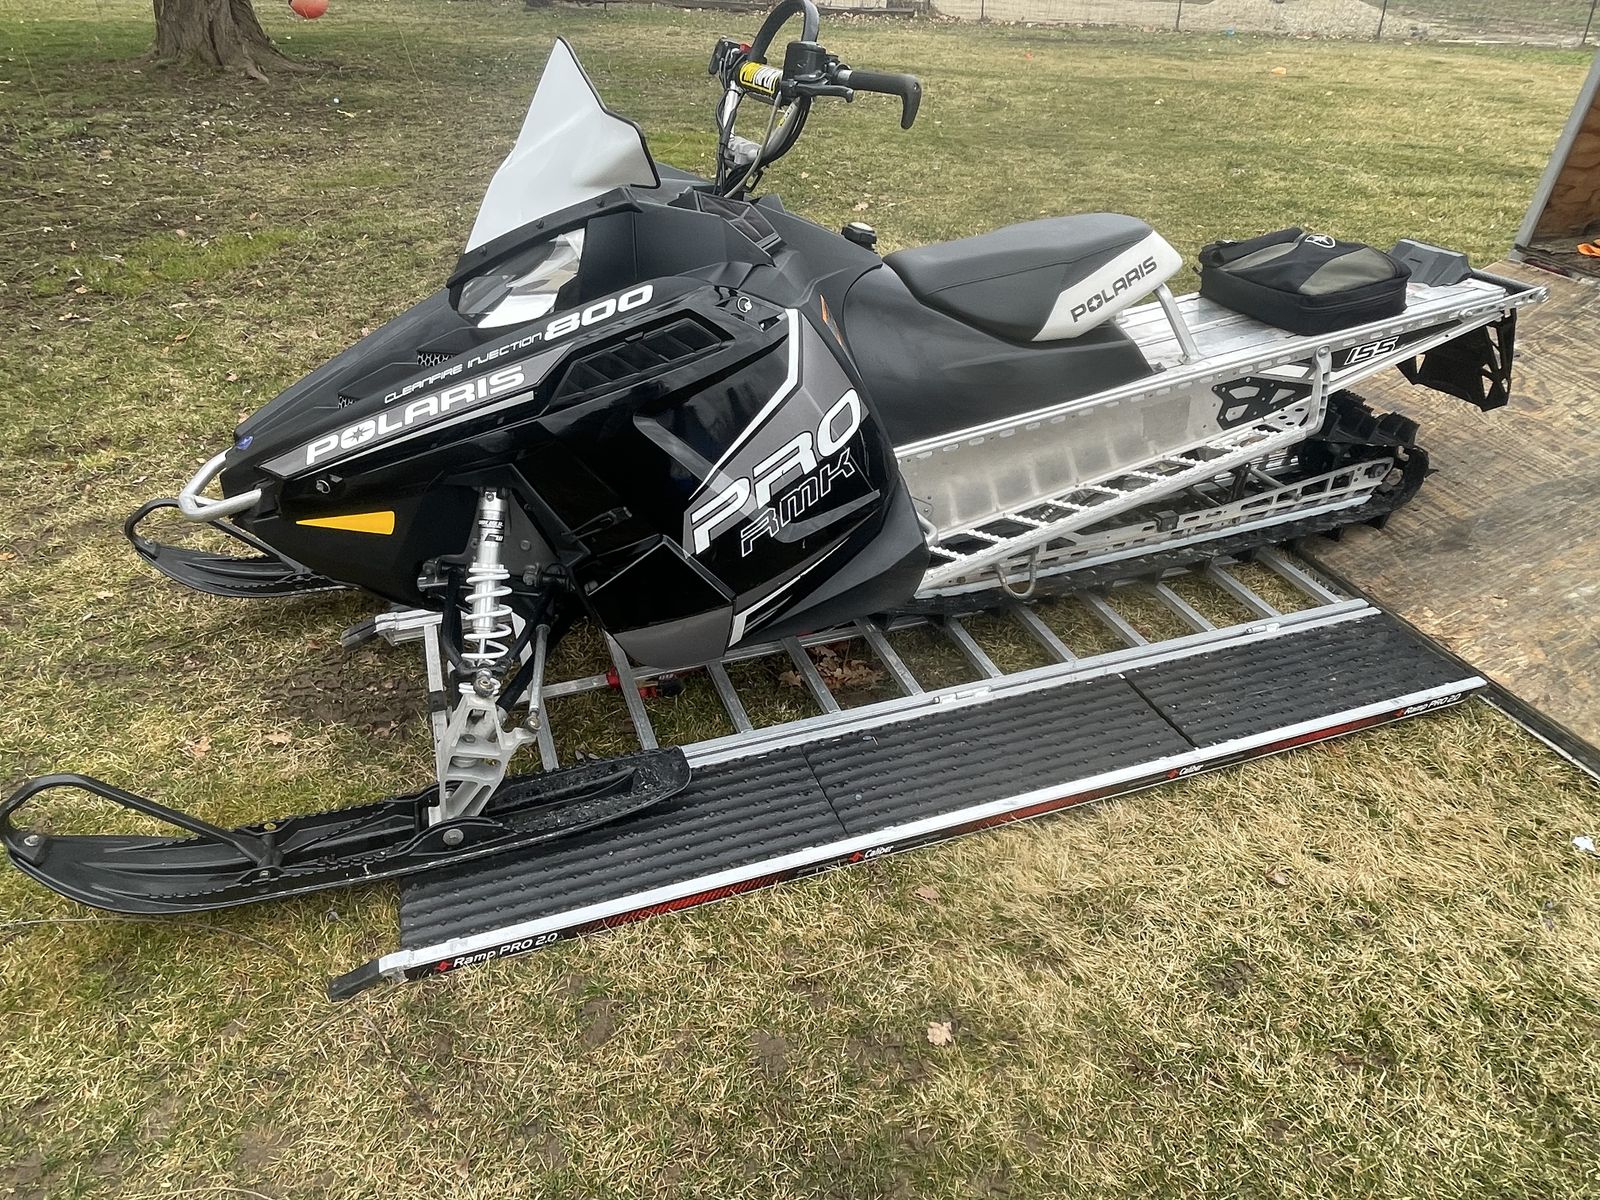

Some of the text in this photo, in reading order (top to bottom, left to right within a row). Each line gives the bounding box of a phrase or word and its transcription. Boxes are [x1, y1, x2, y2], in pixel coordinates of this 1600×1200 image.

[1069, 255, 1158, 323] POLARIS
[384, 284, 655, 404] CLEANFIRE INJECTION 800
[1343, 335, 1400, 366] 155
[305, 364, 526, 466] POLARIS
[690, 388, 862, 555] PRO
[864, 845, 894, 858] Caliber
[453, 932, 558, 968] Ramp PRO 2.0
